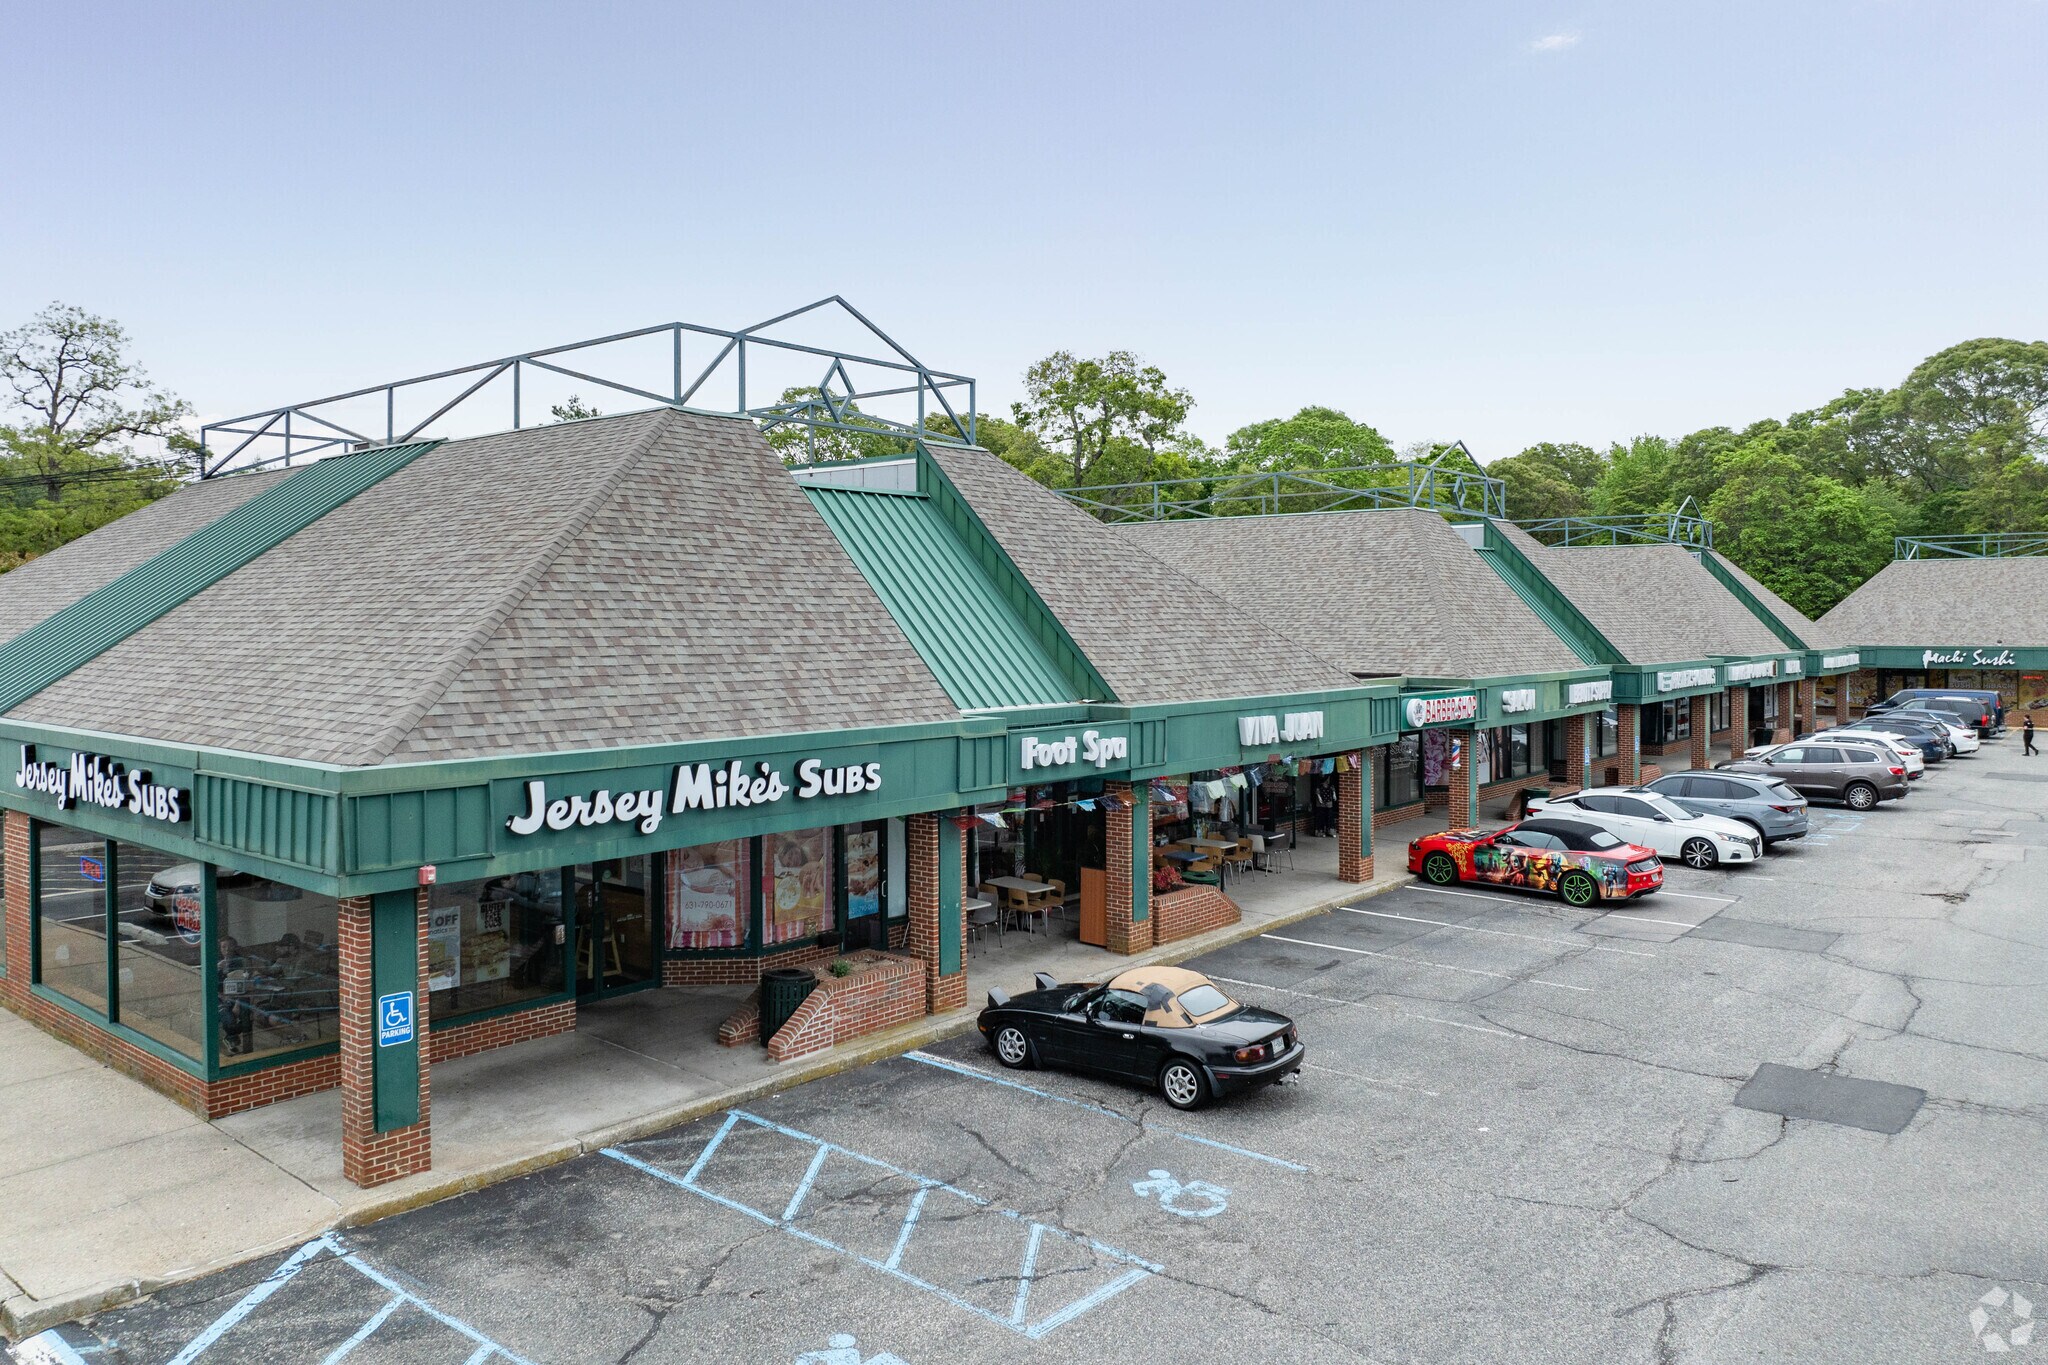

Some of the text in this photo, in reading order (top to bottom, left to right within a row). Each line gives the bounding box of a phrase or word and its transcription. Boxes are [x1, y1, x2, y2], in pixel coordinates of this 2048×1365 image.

[1923, 648, 2015, 669] Machi Sushi
[1239, 711, 1324, 746] VIVA JUAN
[1022, 730, 1127, 769] Foot Spa
[16, 744, 181, 824] Jersey Mike's SUBS
[505, 758, 882, 835] Jersey Mike's SUBS
[685, 900, 732, 910] 631-790-0671
[435, 914, 459, 927] OFF
[381, 1026, 411, 1040] PARKING
